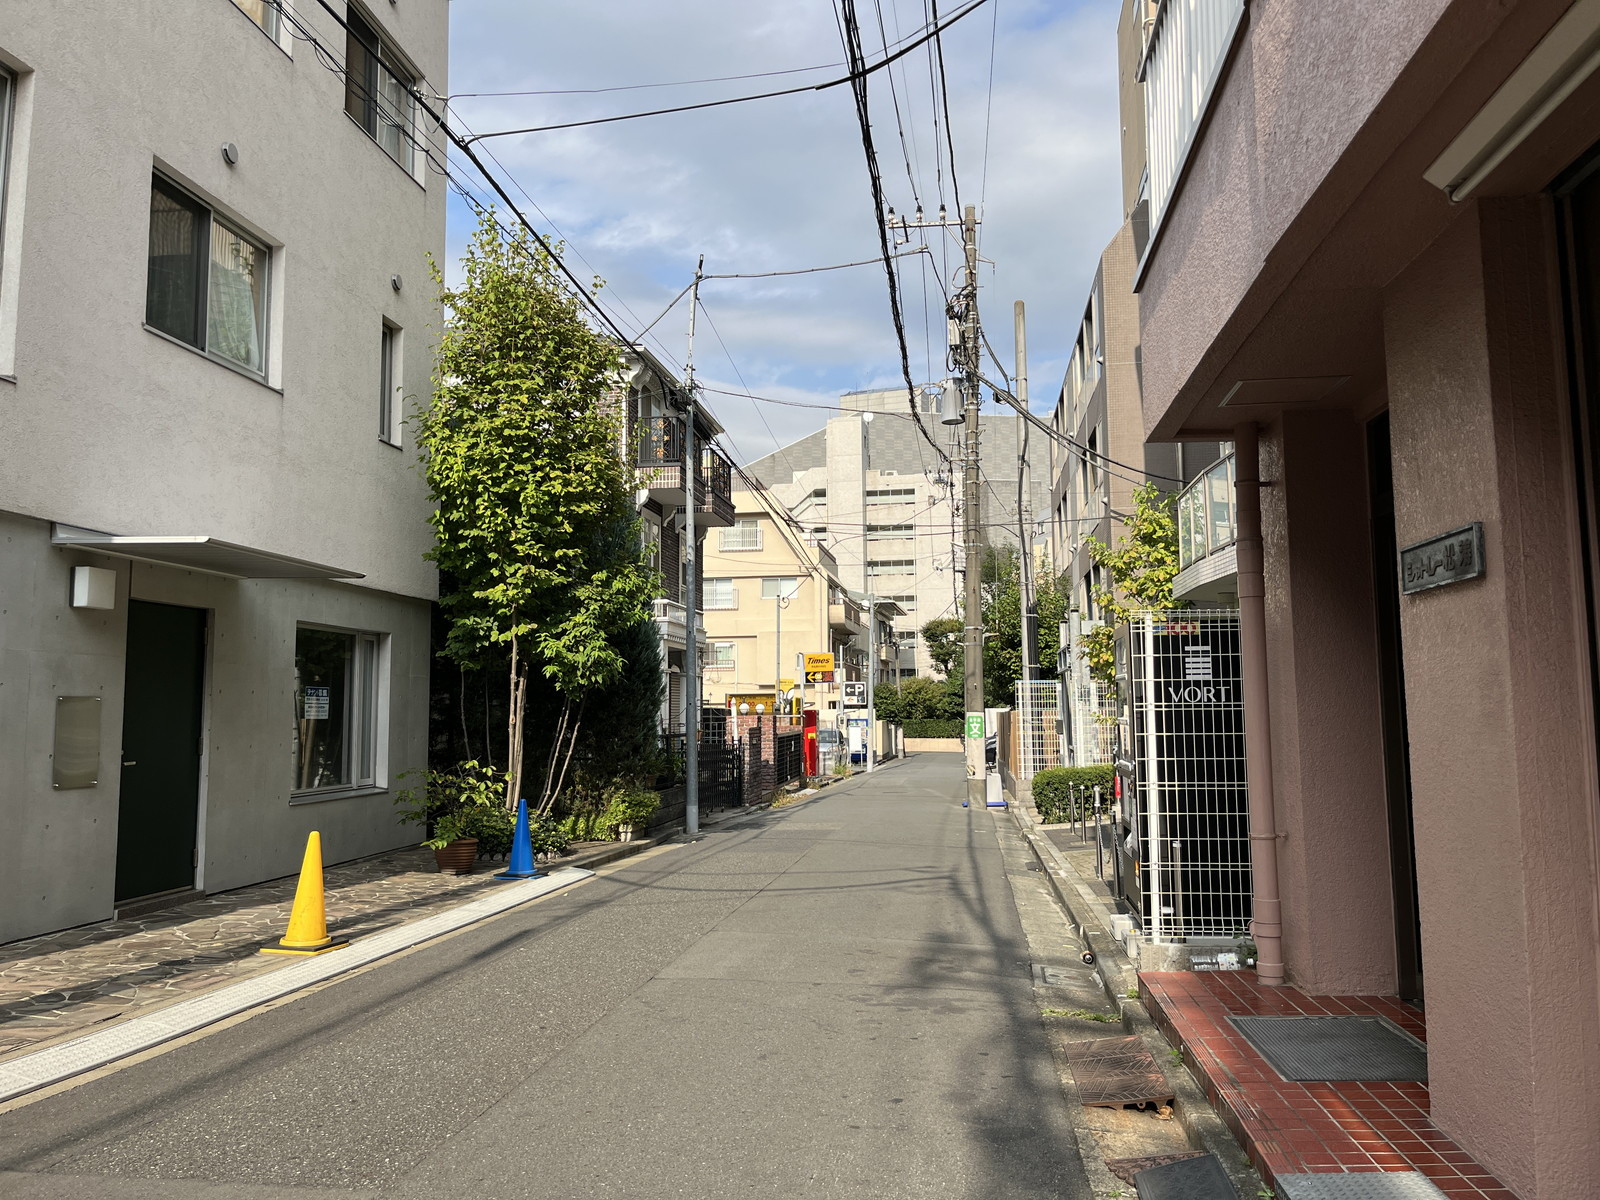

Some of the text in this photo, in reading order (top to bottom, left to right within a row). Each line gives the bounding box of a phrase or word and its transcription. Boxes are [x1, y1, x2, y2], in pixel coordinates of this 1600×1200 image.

[807, 657, 830, 665] Times
[854, 684, 864, 696] P
[1168, 686, 1231, 703] VORT
